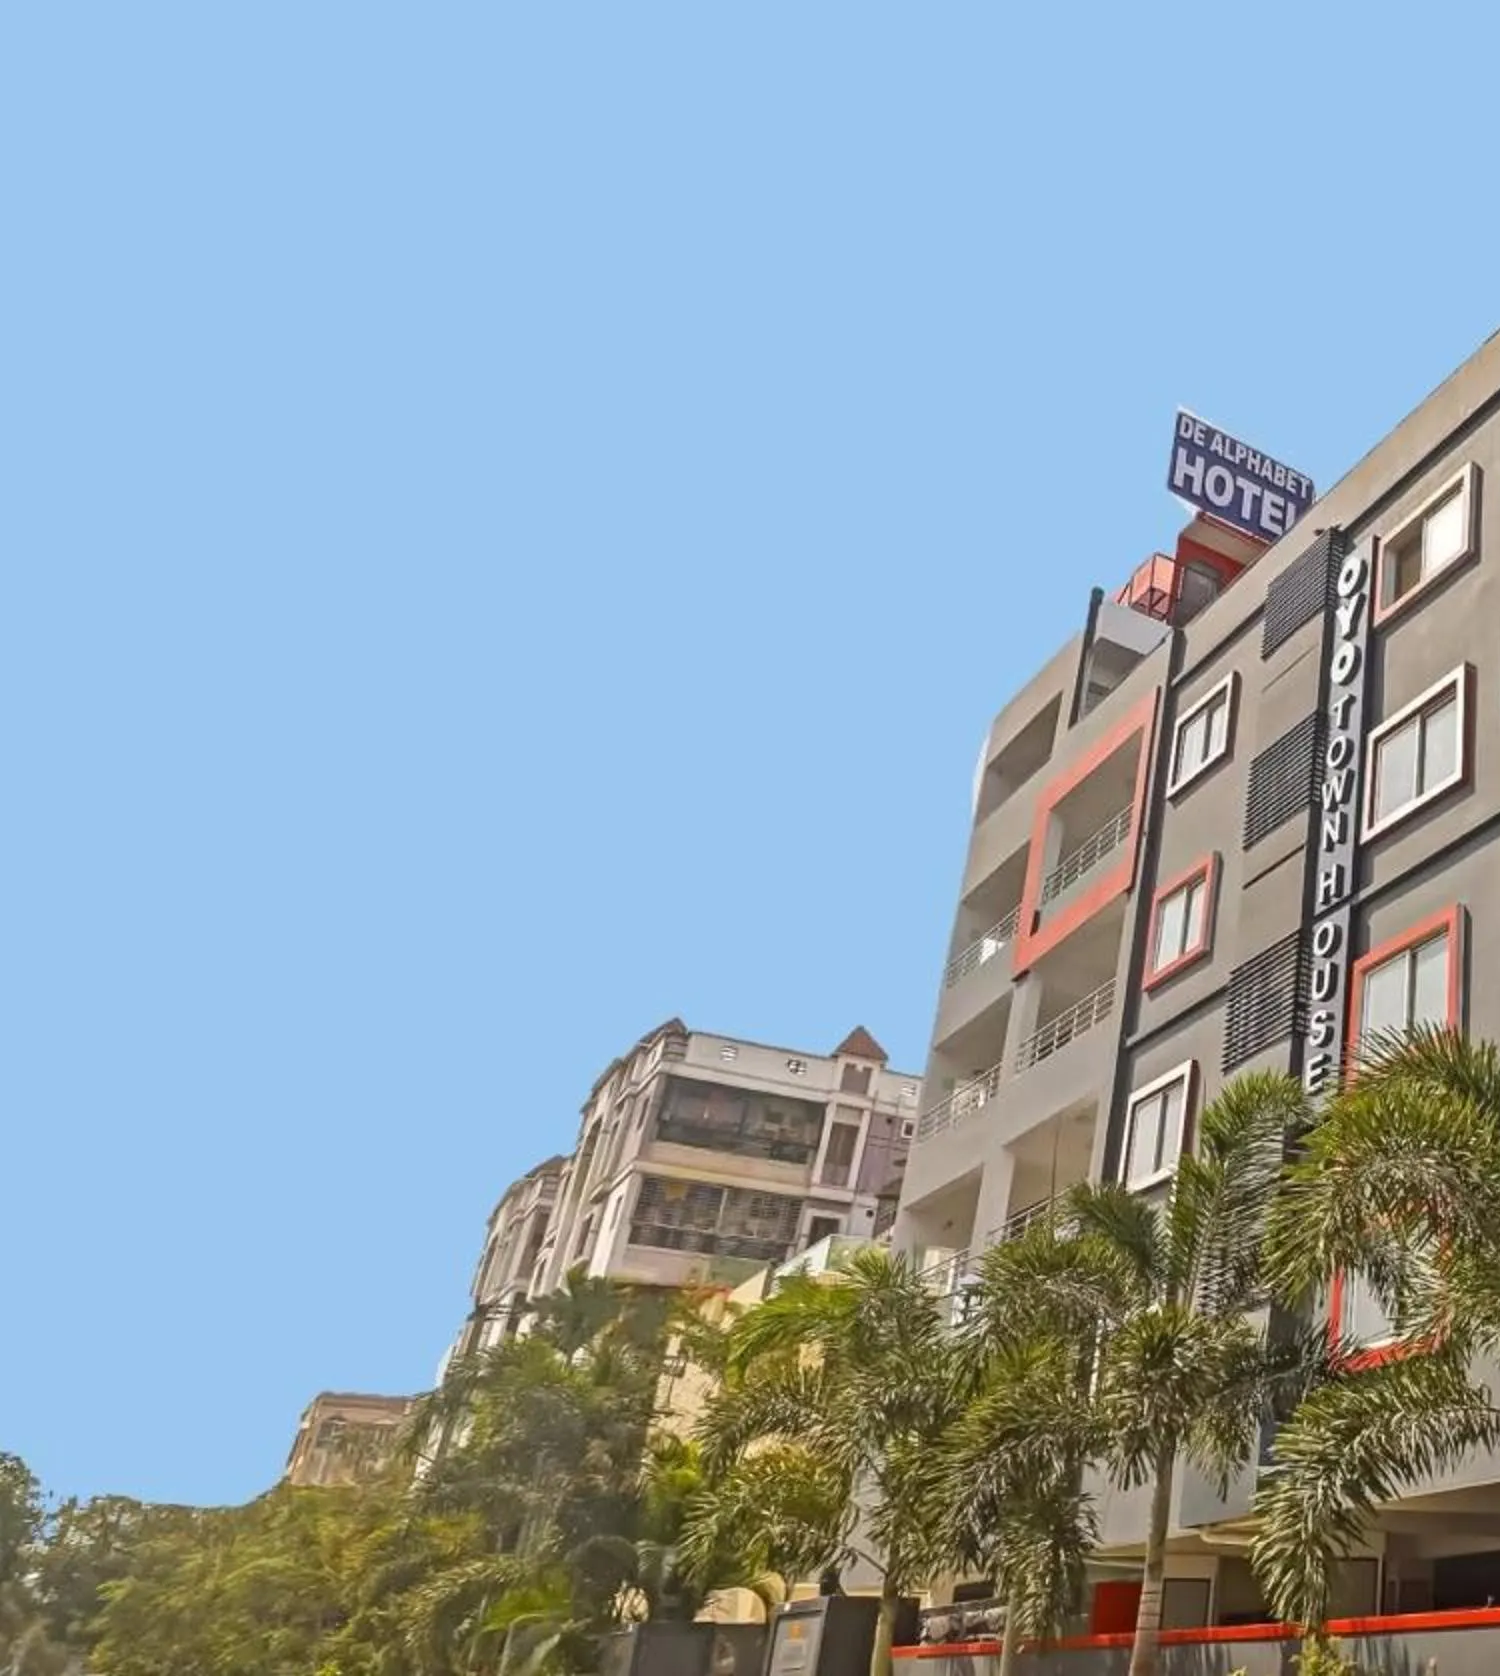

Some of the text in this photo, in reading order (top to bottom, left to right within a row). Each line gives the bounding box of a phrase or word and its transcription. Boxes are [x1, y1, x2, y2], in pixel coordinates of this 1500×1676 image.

[1179, 415, 1311, 499] DE ALPHABET
[1304, 556, 1368, 1097] OYO TOWN HOUSE
